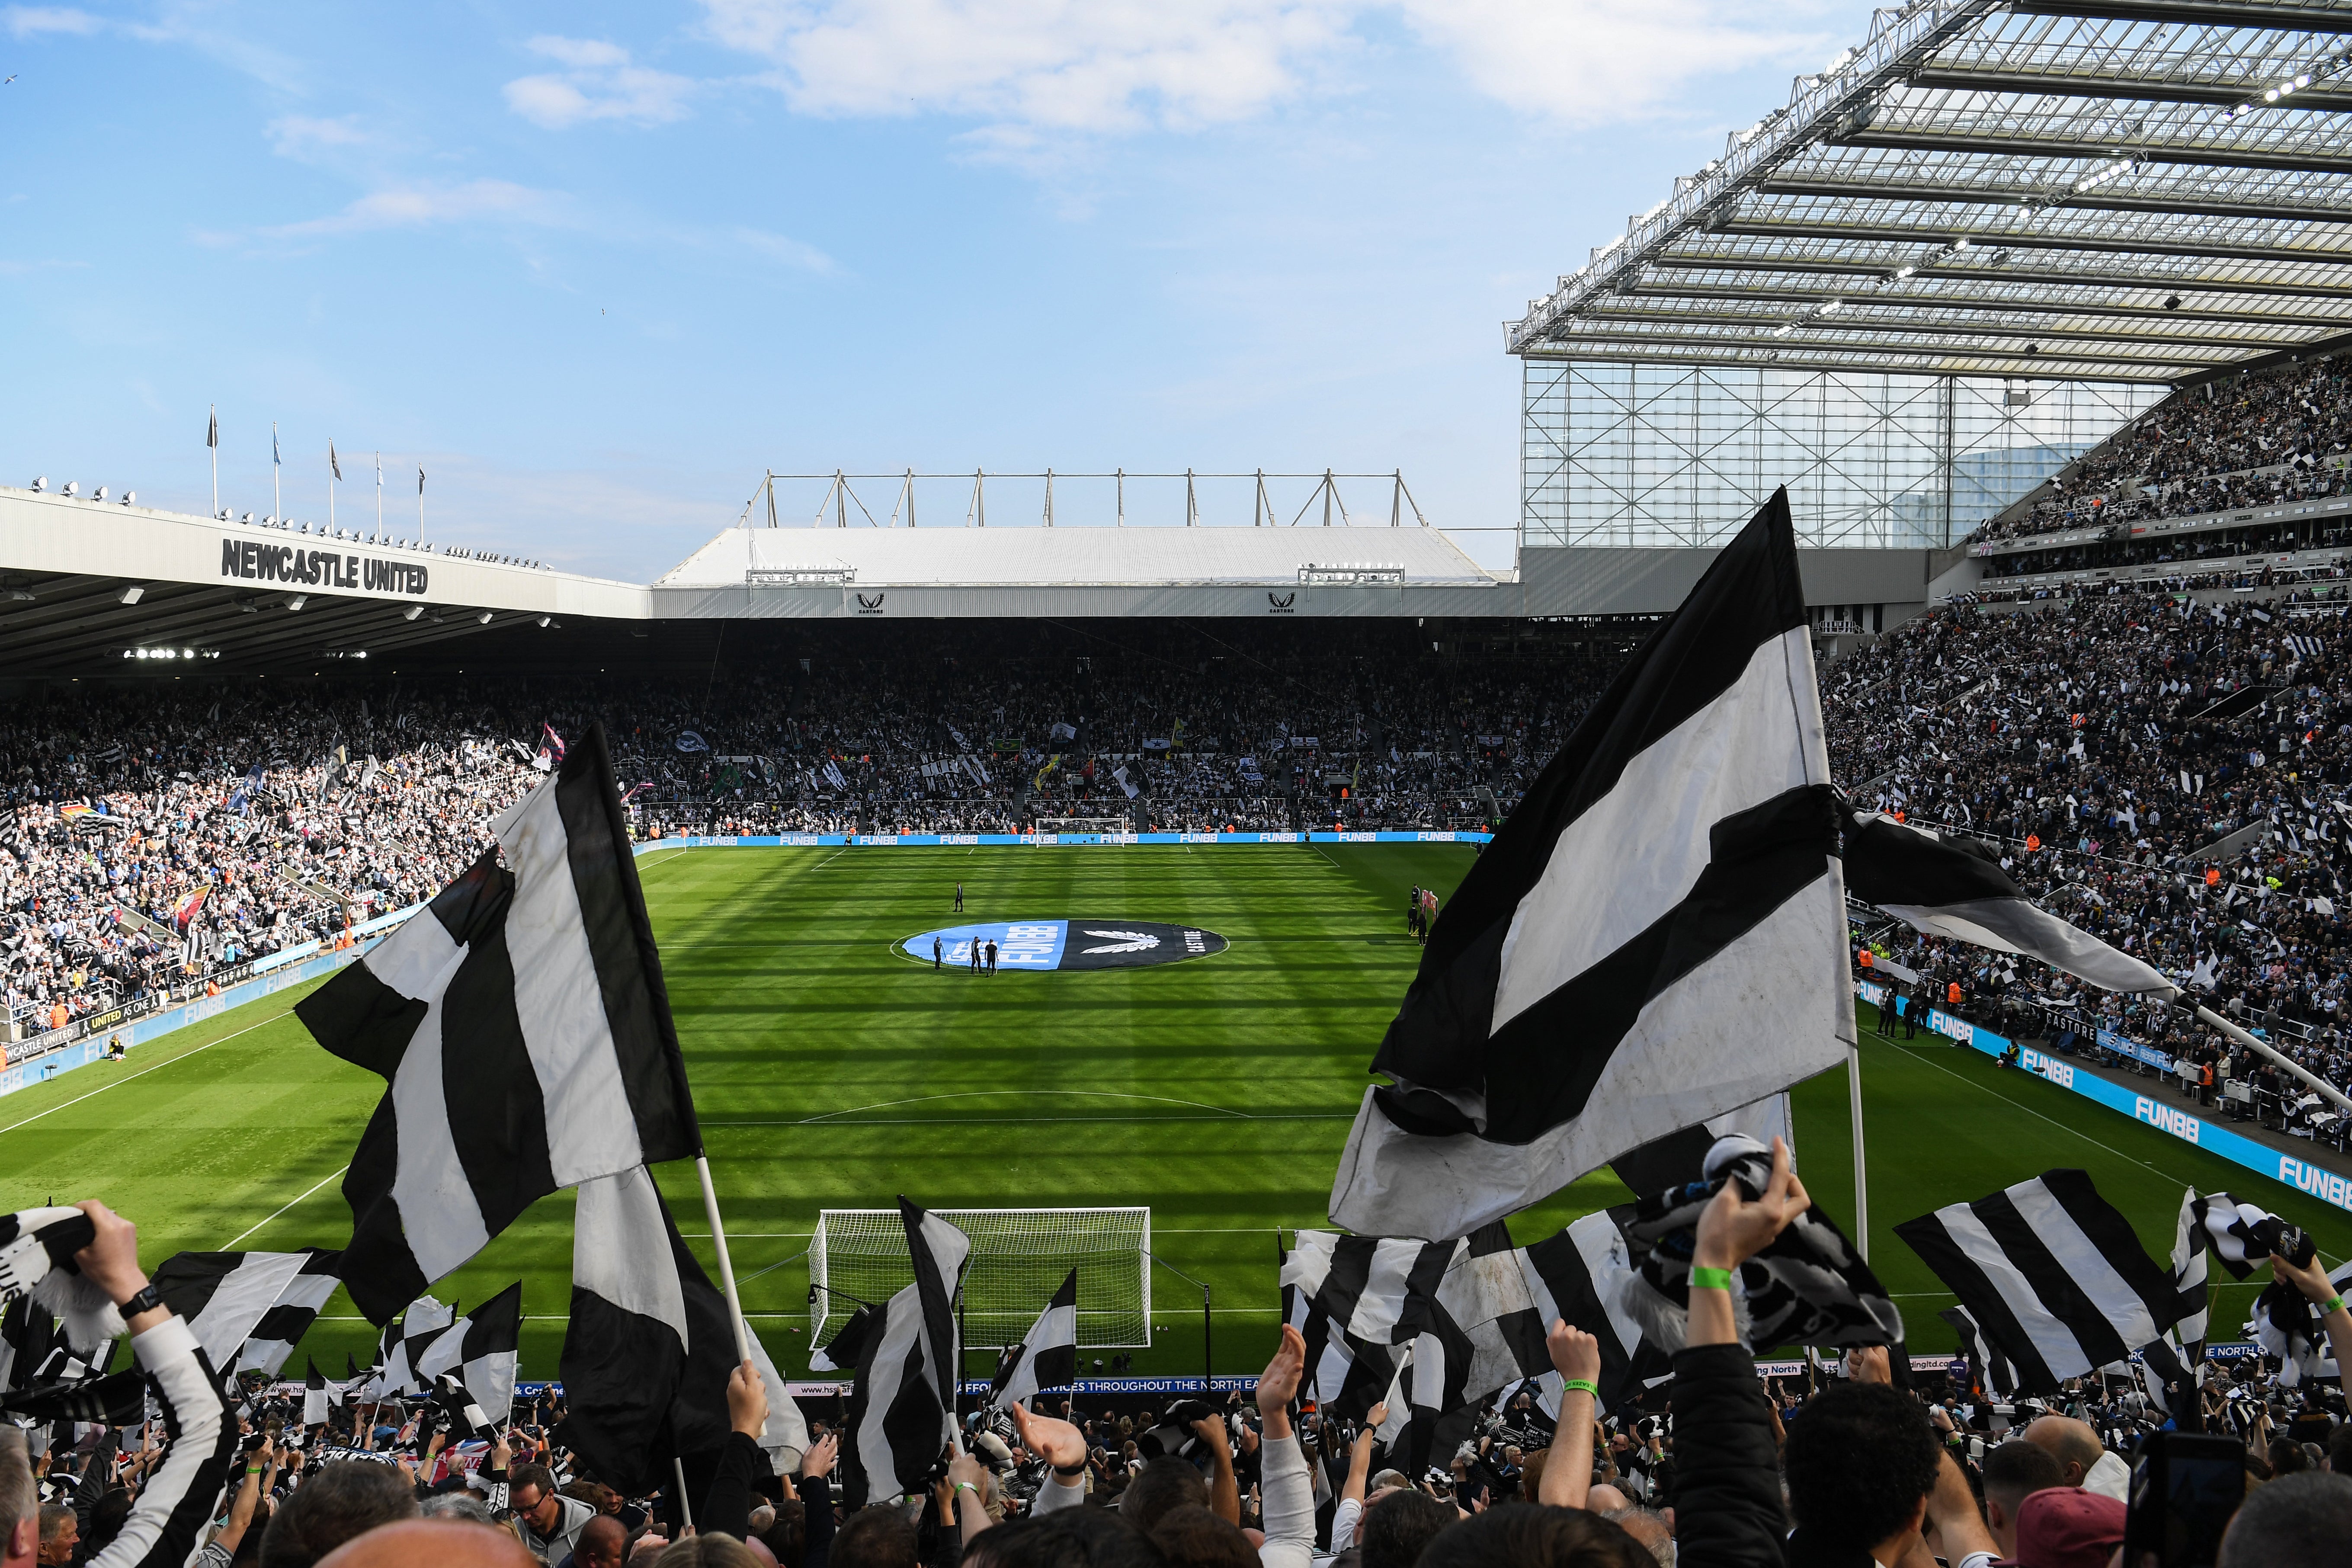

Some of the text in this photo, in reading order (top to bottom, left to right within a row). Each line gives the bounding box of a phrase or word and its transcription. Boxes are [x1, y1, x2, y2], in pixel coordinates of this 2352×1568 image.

[222, 539, 428, 595] NEWCASTLE UNITED
[928, 760, 955, 775] THE
[699, 837, 737, 846] FUN88
[780, 837, 818, 845] FUN88
[859, 835, 898, 845] FUN88
[940, 835, 979, 844] FUN88
[1019, 834, 1057, 844] FUN88
[1100, 834, 1138, 843] FUN88
[1179, 833, 1218, 843] FUN88
[1259, 833, 1297, 842] FUN88
[1338, 832, 1376, 842] FUN88
[1417, 831, 1455, 841] FUN88
[997, 926, 1059, 963] FUN88
[1184, 931, 1206, 952] CASTORE
[266, 967, 301, 994] FUN88
[91, 999, 150, 1029] UNITED AS ONE
[185, 994, 225, 1025] FUN88
[1932, 1011, 1974, 1045] FUN88
[2046, 1012, 2094, 1040] CASTORE
[6, 1028, 73, 1058] WCASTLE UNITED
[2022, 1049, 2073, 1088] FUN88
[2135, 1096, 2200, 1144] FUN88
[1771, 1365, 1798, 1373] North
[1088, 1381, 1172, 1391] THROUGHOUT
[1174, 1380, 1197, 1390] THE
[1201, 1380, 1241, 1390] NORTH
[1245, 1380, 1259, 1389] EA
